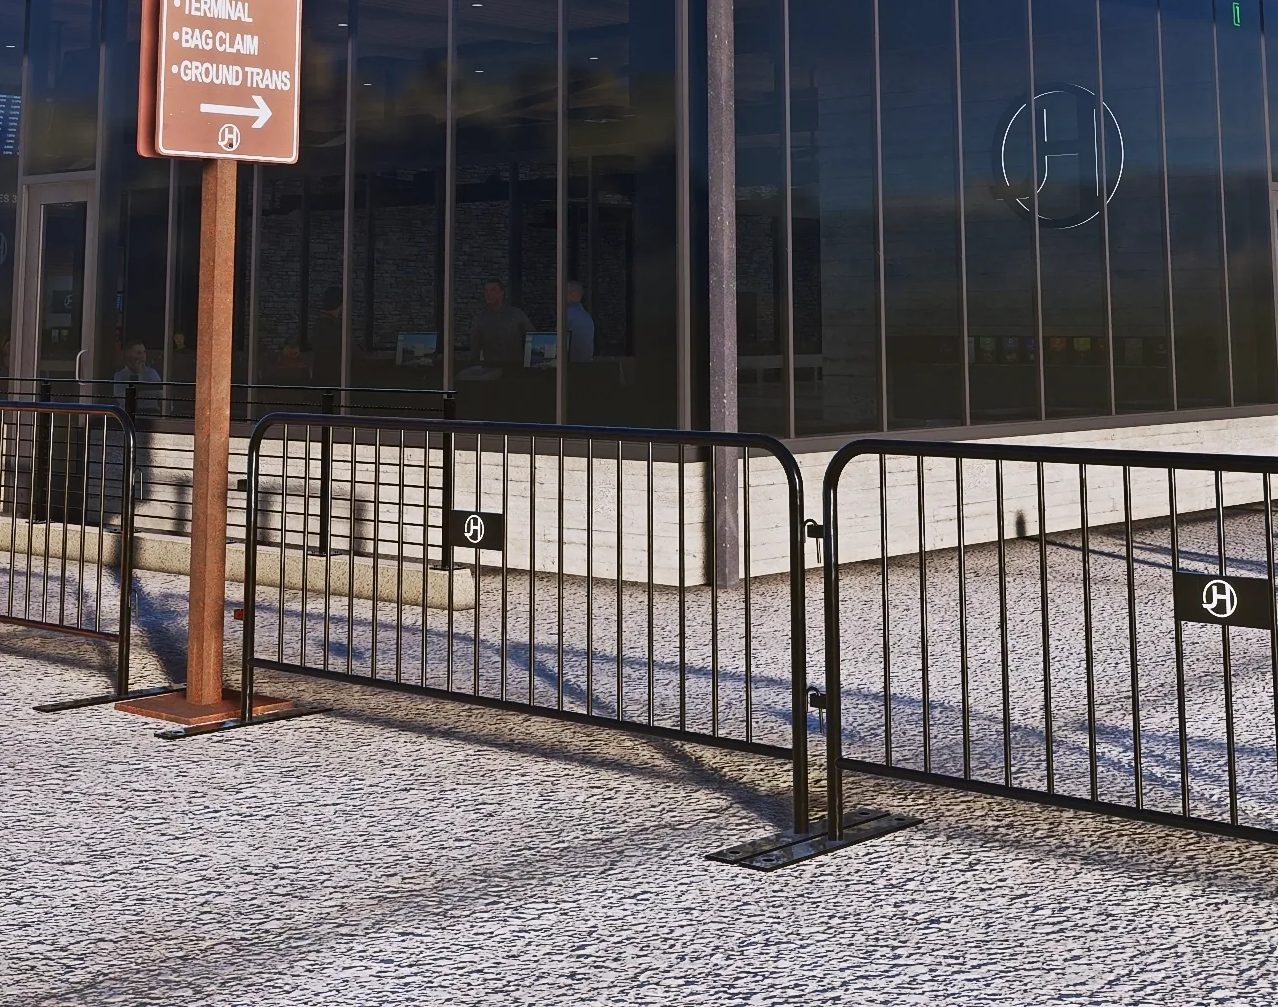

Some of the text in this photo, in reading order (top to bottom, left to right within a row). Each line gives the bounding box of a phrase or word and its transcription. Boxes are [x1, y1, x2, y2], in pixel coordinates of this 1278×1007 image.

[181, 26, 259, 56] BAG CLAIM
[179, 59, 291, 91] GROUND TRANS
